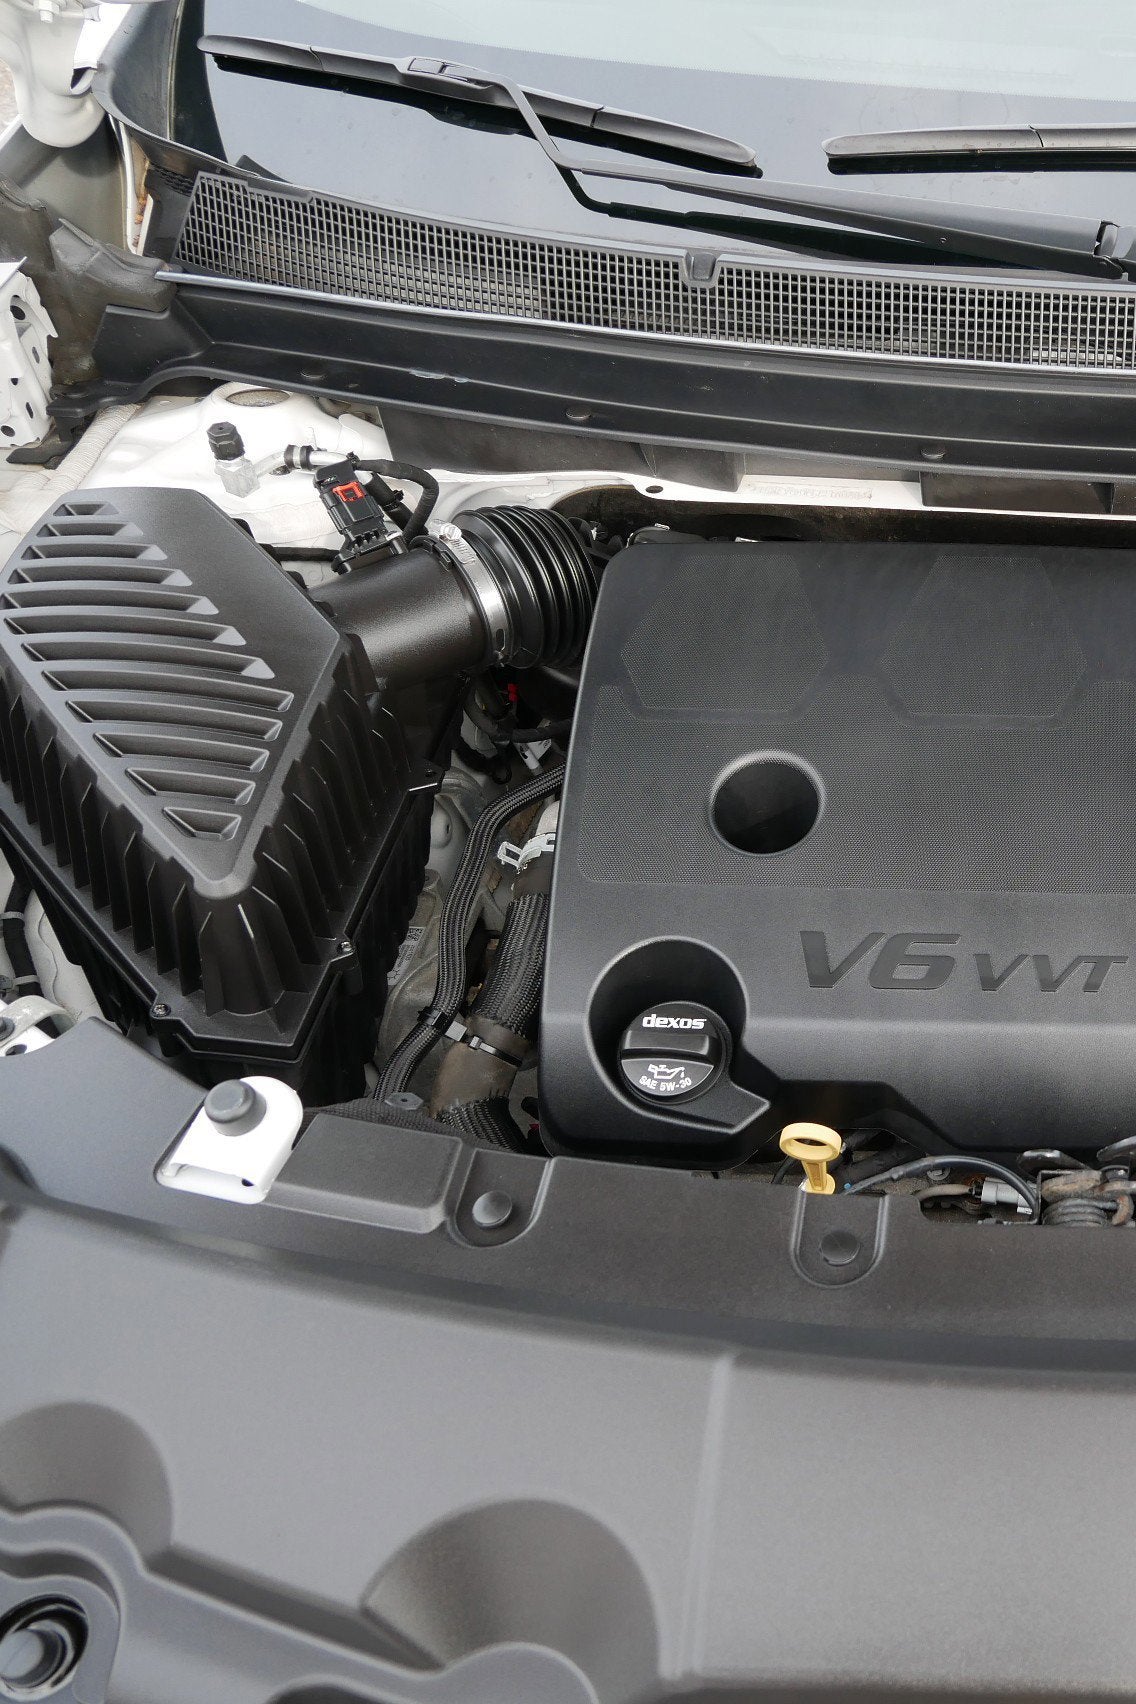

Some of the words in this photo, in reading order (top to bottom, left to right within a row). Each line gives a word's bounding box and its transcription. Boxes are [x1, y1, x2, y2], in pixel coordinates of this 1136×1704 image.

[799, 930, 962, 991] V6
[972, 953, 1129, 993] VVT
[641, 1013, 705, 1030] dexos
[638, 1075, 659, 1090] SAE
[659, 1077, 692, 1092] 5W-30
